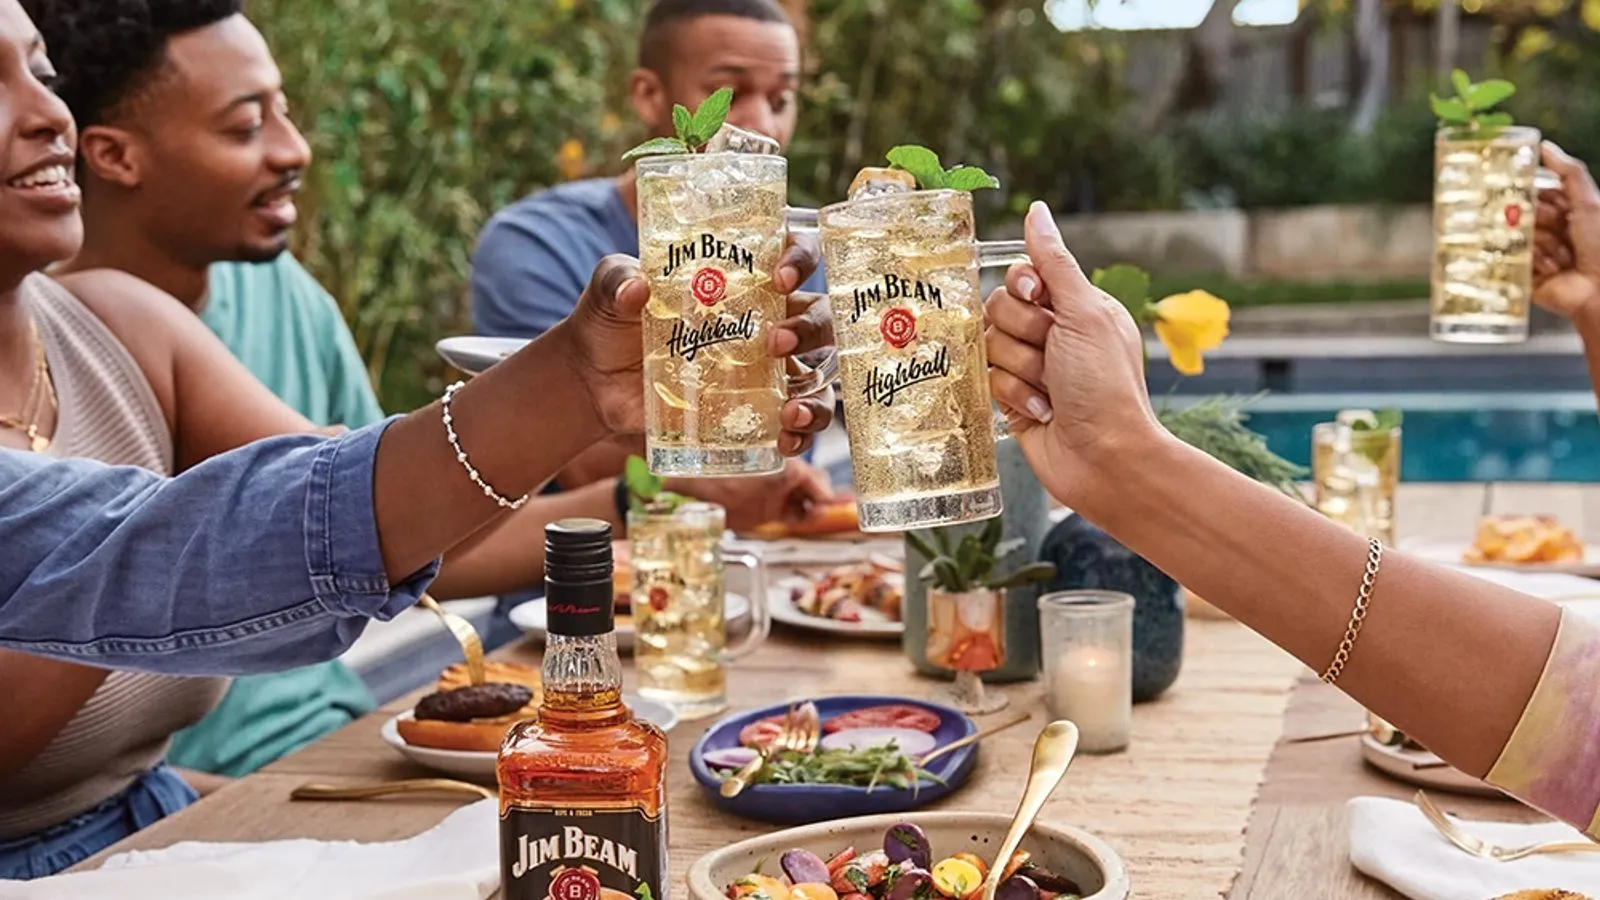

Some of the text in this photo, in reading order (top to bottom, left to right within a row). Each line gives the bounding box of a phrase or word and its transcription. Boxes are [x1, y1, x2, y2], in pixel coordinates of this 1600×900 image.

[663, 233, 754, 277] JIM BEAM
[851, 273, 943, 323] JIM BEAM
[666, 309, 755, 362] Highball
[862, 345, 951, 407] Highball
[512, 825, 638, 880] JIM BEAM
[569, 884, 581, 898] B
